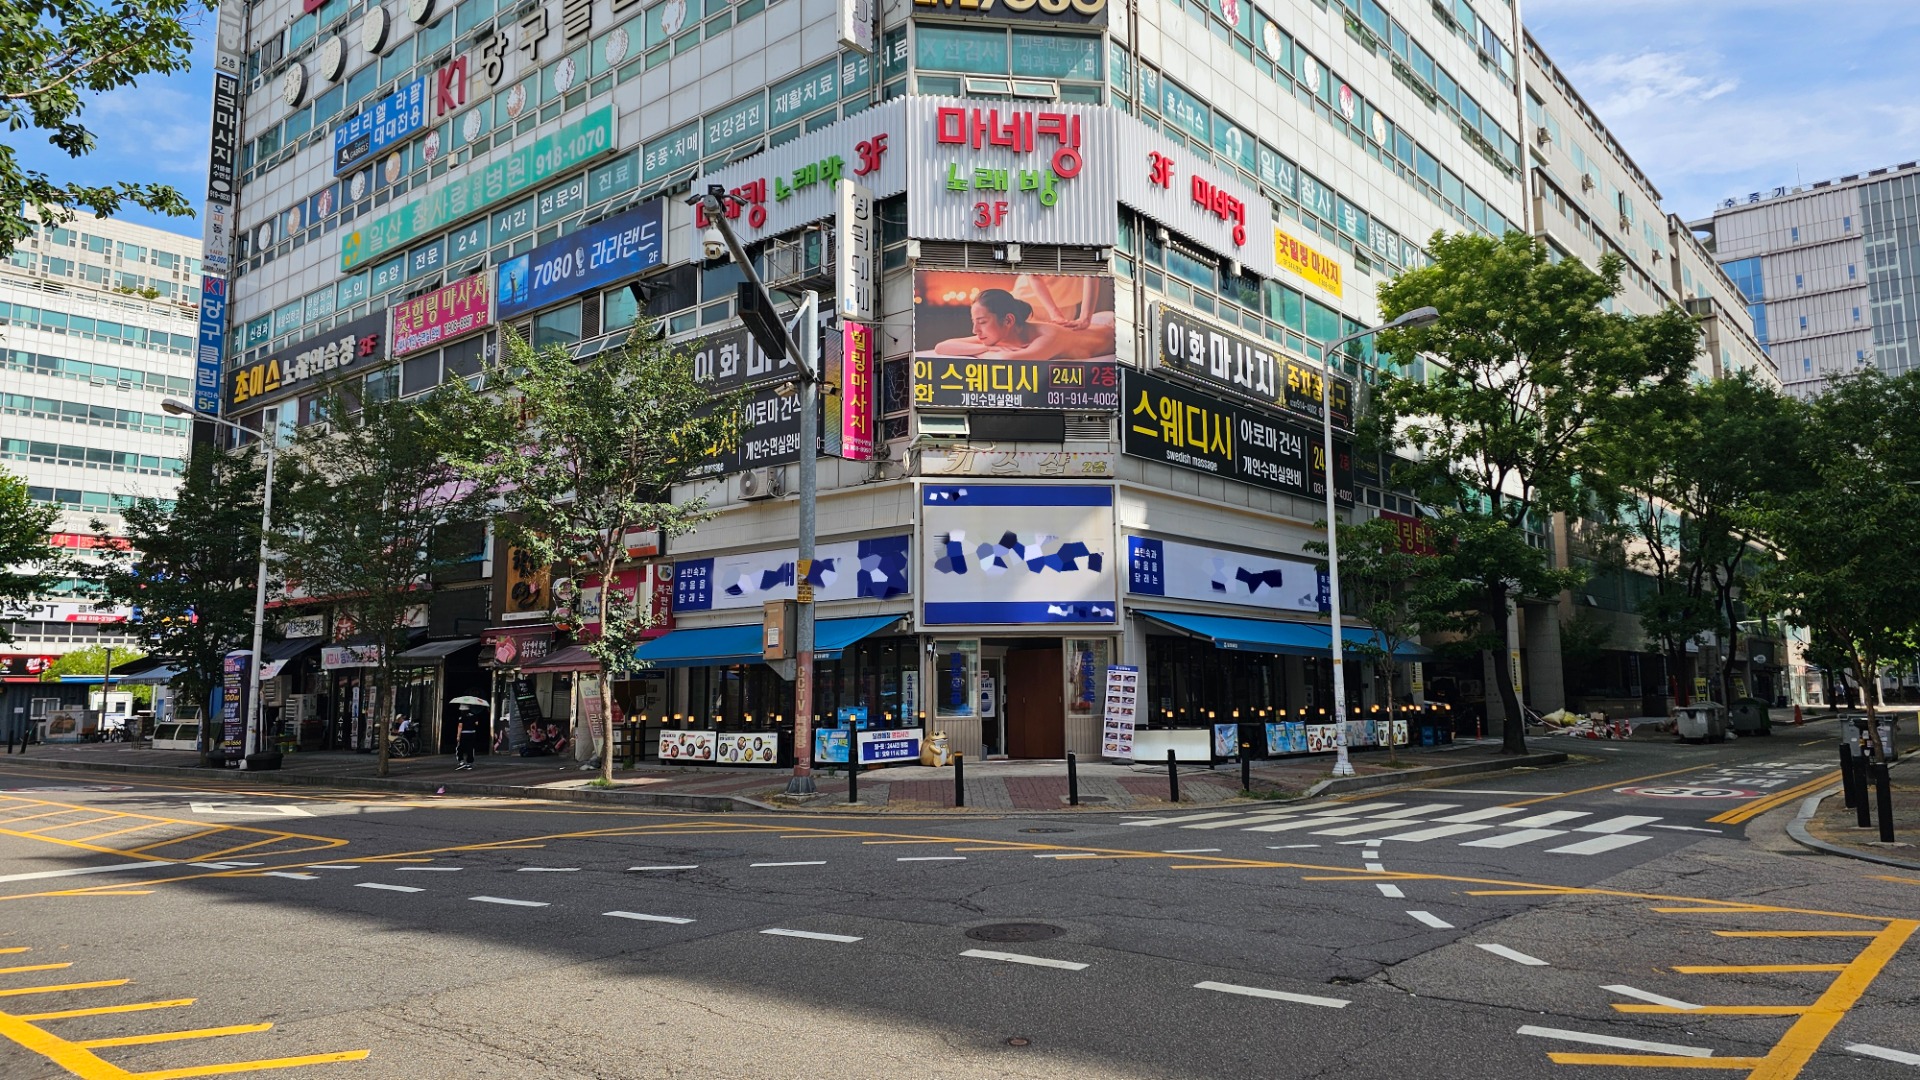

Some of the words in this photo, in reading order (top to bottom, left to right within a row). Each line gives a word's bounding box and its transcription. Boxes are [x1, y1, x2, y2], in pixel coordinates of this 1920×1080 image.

[221, 56, 236, 69] 2층
[437, 55, 466, 116] K1
[213, 78, 236, 164] 태국마사지
[338, 102, 386, 144] 가브리엘
[374, 105, 421, 145] 대대전용
[1167, 91, 1204, 131] 호스피스
[938, 106, 1083, 179] 마네킹
[342, 280, 363, 302] 노인
[377, 264, 399, 286] 요양
[415, 247, 438, 270] 전문
[459, 229, 478, 252] 24
[500, 208, 527, 233] 시간
[541, 180, 583, 215] 전문의
[599, 163, 630, 192] 진료
[709, 104, 760, 144] 건강검진
[774, 73, 834, 115] 재활치료
[369, 220, 401, 249] 일산
[412, 185, 467, 233] 참사랑
[486, 154, 525, 198] 병원
[536, 125, 605, 176] 918-1070
[775, 154, 846, 202] 노래방
[854, 132, 888, 177] 3F
[946, 162, 1061, 208] 노래방
[974, 201, 1009, 228] 3F
[1148, 150, 1175, 190] 3F
[1192, 174, 1247, 247] 마네킹
[1260, 149, 1293, 195] 일산
[1301, 175, 1357, 233] 참사랑
[1376, 225, 1398, 261] 병원
[533, 252, 573, 289] 7080
[589, 220, 657, 270] 라라랜드
[648, 250, 659, 264] 2F
[1311, 251, 1339, 285] 마사지
[205, 276, 224, 296] K1
[398, 294, 439, 337] 굿힐링
[443, 275, 487, 317] 마사지
[476, 311, 487, 323] 3F
[198, 298, 224, 388] 당구클럽
[281, 334, 356, 386] 노래연습장
[358, 333, 378, 357] 3F
[1209, 330, 1275, 398] 마사지
[850, 330, 867, 434] 힐링마사지
[940, 363, 1039, 394] 스웨디시
[1052, 366, 1083, 387] 24시
[1091, 366, 1116, 387] 2층
[961, 392, 1022, 407] 개인수면실완비
[1047, 391, 1117, 406] 031-914-4002
[198, 397, 214, 410] 5F
[745, 398, 779, 427] 아로마
[1132, 389, 1233, 461] 스웨디시
[1240, 417, 1277, 452] 아로마
[1279, 430, 1302, 460] 건식
[1082, 460, 1107, 473] 2층
[1166, 449, 1191, 467] swedish
[1192, 455, 1218, 472] massage
[1243, 455, 1302, 488] 개인수면실완비
[657, 584, 673, 595] 복권
[797, 666, 806, 712] CCTV
